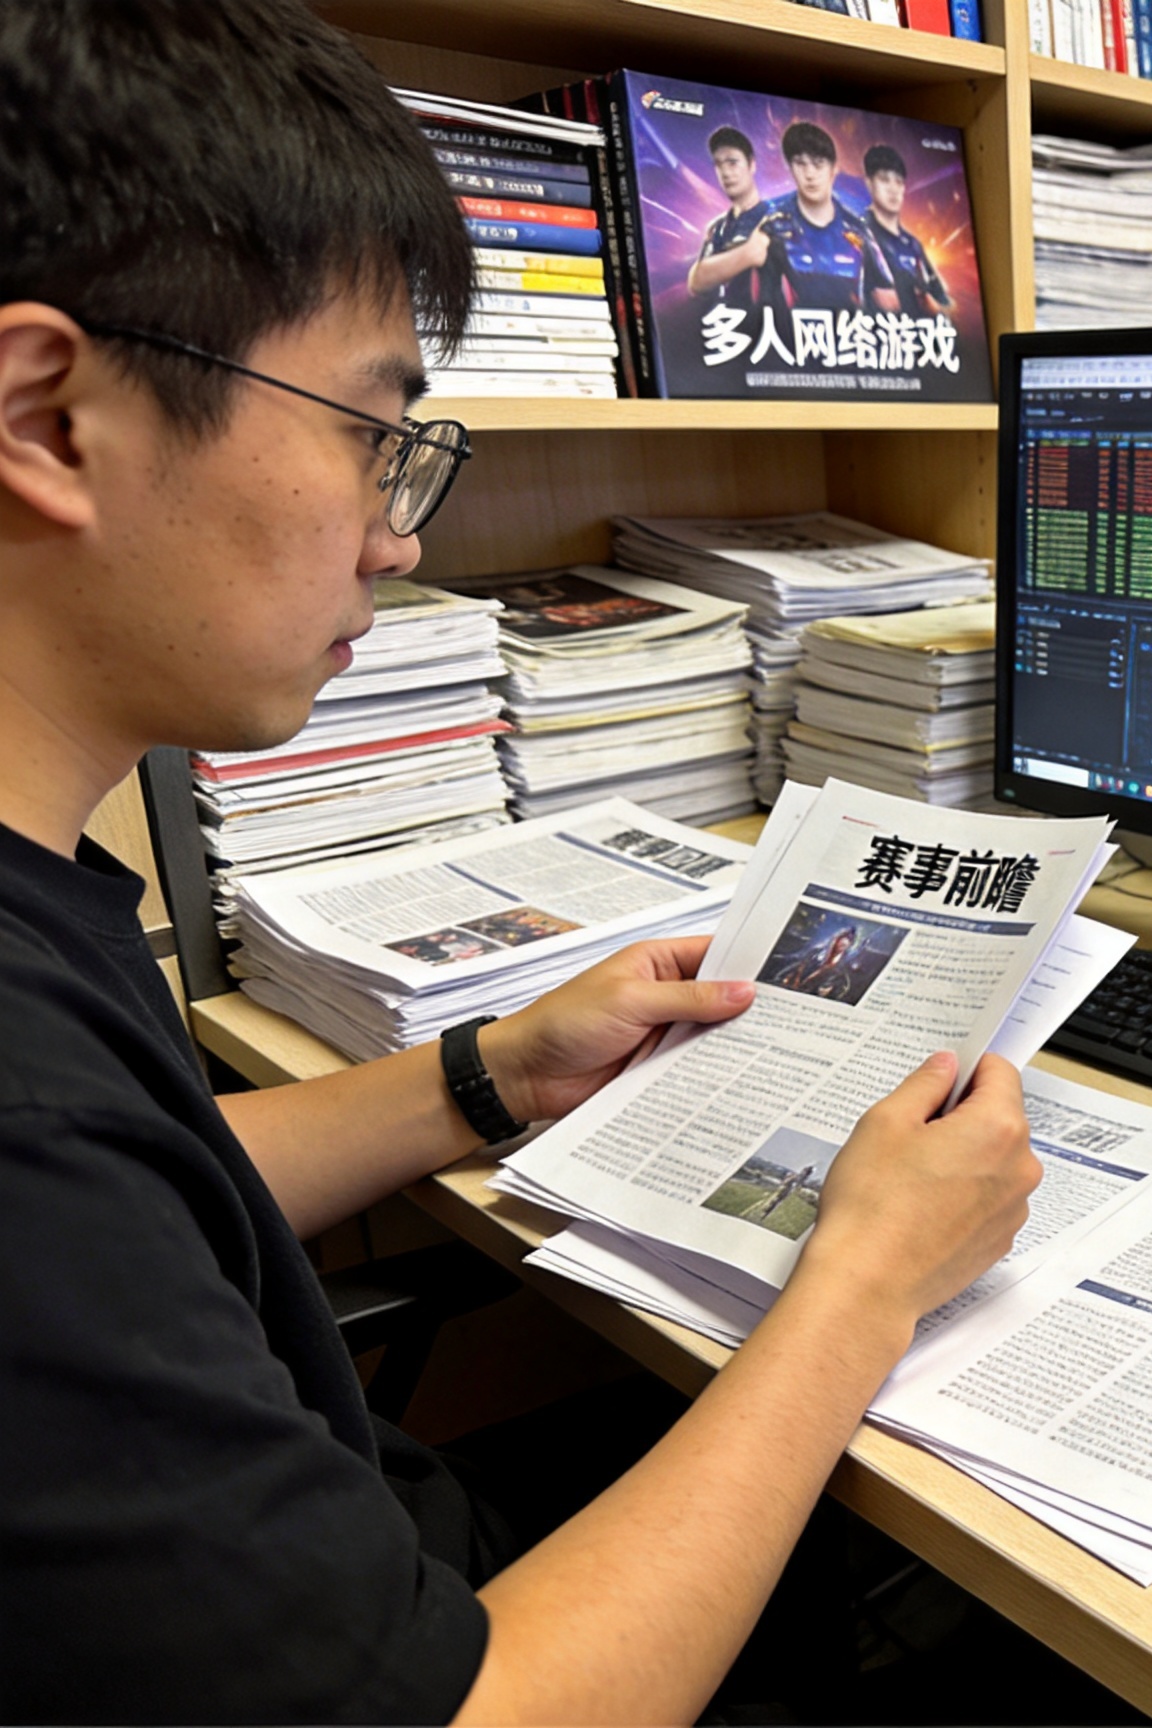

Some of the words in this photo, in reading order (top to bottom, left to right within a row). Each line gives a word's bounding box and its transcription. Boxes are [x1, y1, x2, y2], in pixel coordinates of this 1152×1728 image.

[701, 303, 960, 373] 多人网络游戏
[854, 835, 1041, 913] 赛事前瞻
